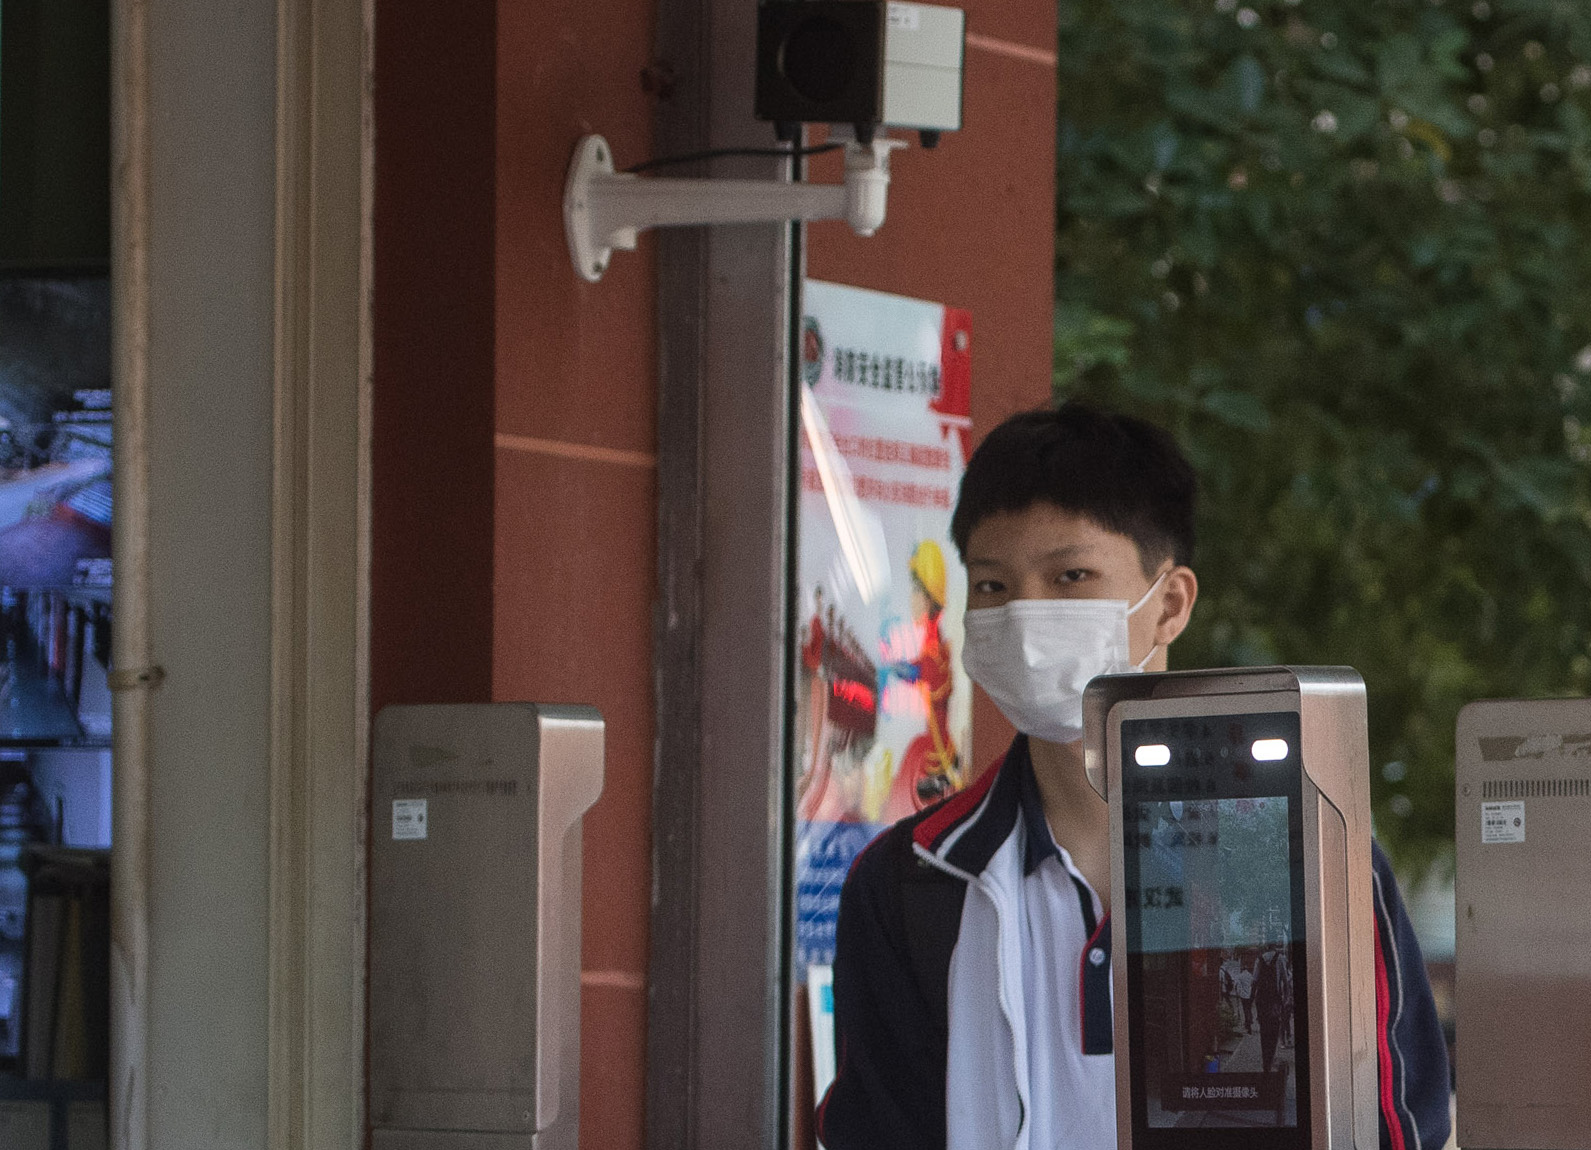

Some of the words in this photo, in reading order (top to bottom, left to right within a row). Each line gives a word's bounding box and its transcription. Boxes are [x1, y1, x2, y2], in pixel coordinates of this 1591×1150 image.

[1182, 1086, 1258, 1099] 请将人脸对准摄像头
